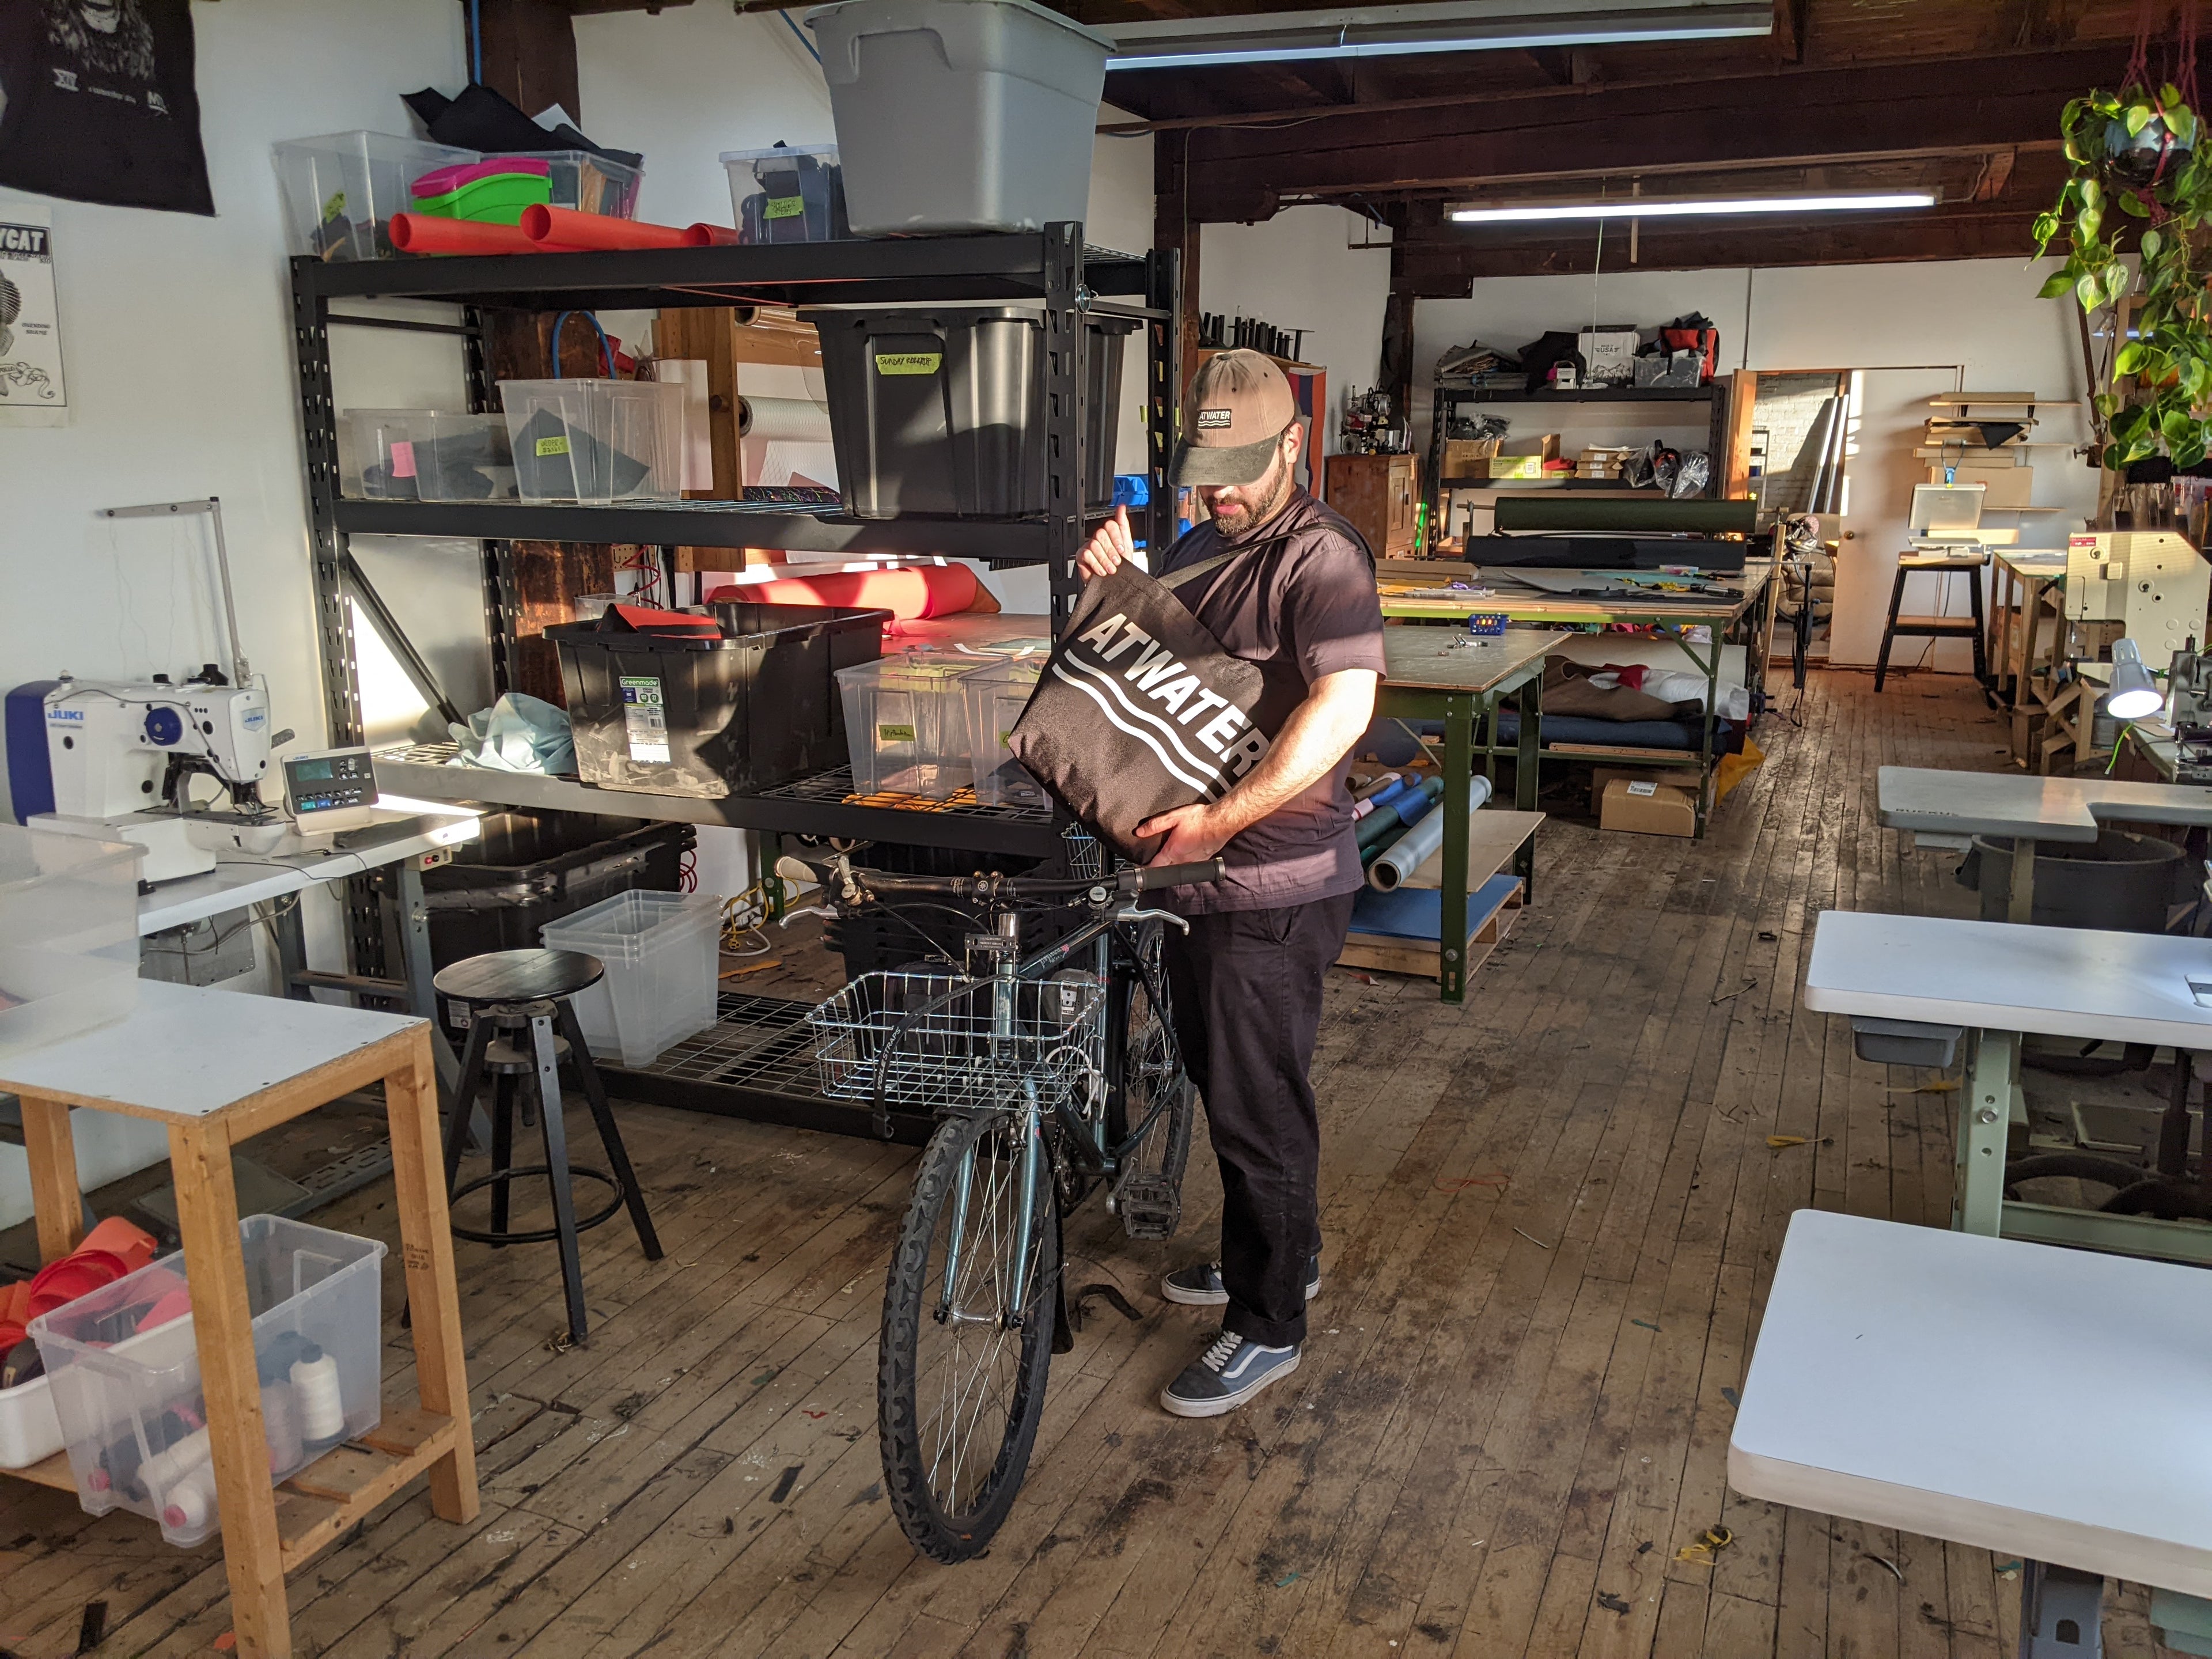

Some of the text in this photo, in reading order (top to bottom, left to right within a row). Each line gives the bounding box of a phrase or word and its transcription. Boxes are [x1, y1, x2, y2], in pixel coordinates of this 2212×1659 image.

[880, 357, 905, 366] SUNDAY
[1199, 411, 1230, 420] ATWATER
[1078, 613, 1270, 777] ATWATER
[47, 710, 84, 721] JUKI
[245, 714, 264, 723] JUKI
[877, 1027, 901, 1090] VOILE STRAPS
